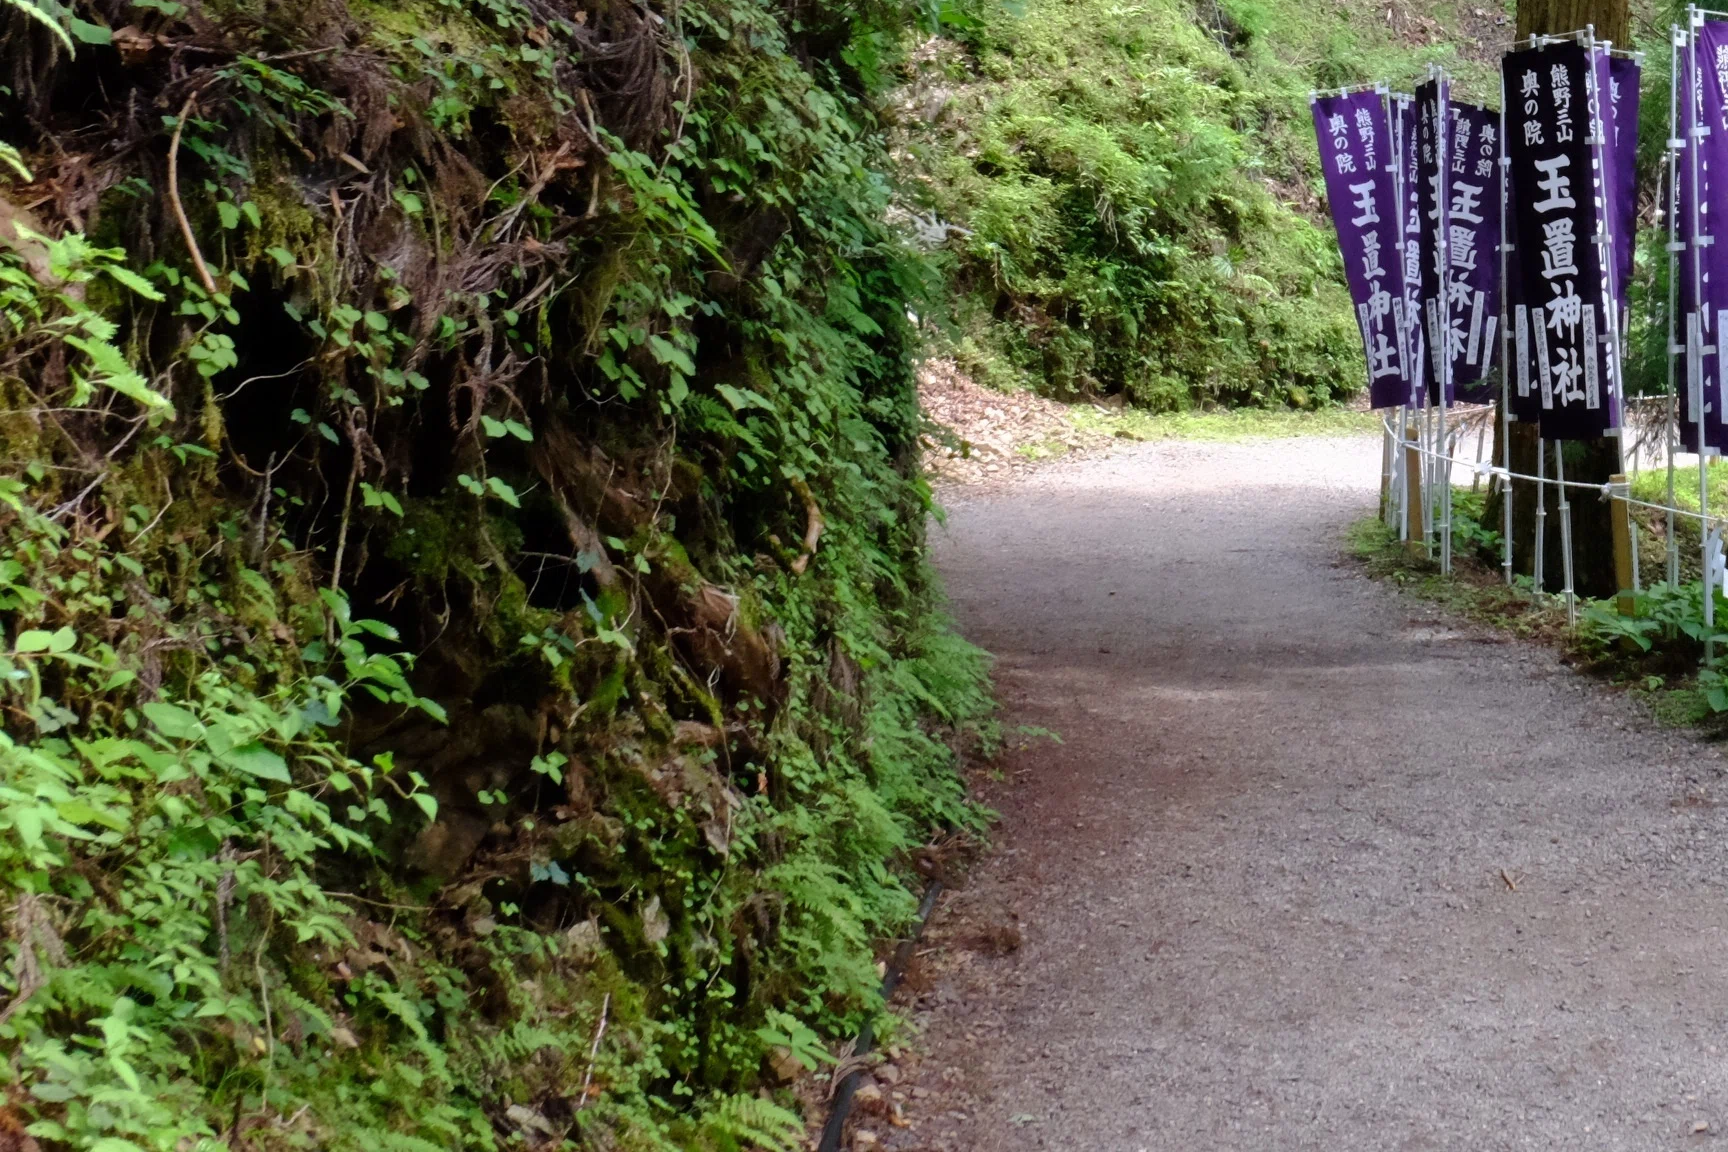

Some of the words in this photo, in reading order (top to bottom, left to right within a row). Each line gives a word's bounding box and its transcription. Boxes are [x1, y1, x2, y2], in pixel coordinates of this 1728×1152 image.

[1355, 108, 1377, 171] 熊野三山
[1520, 69, 1545, 146] 奥の院
[1550, 64, 1574, 143] 熊野三山
[1329, 113, 1357, 174] 奥の院
[1533, 154, 1586, 407] 玉置神社
